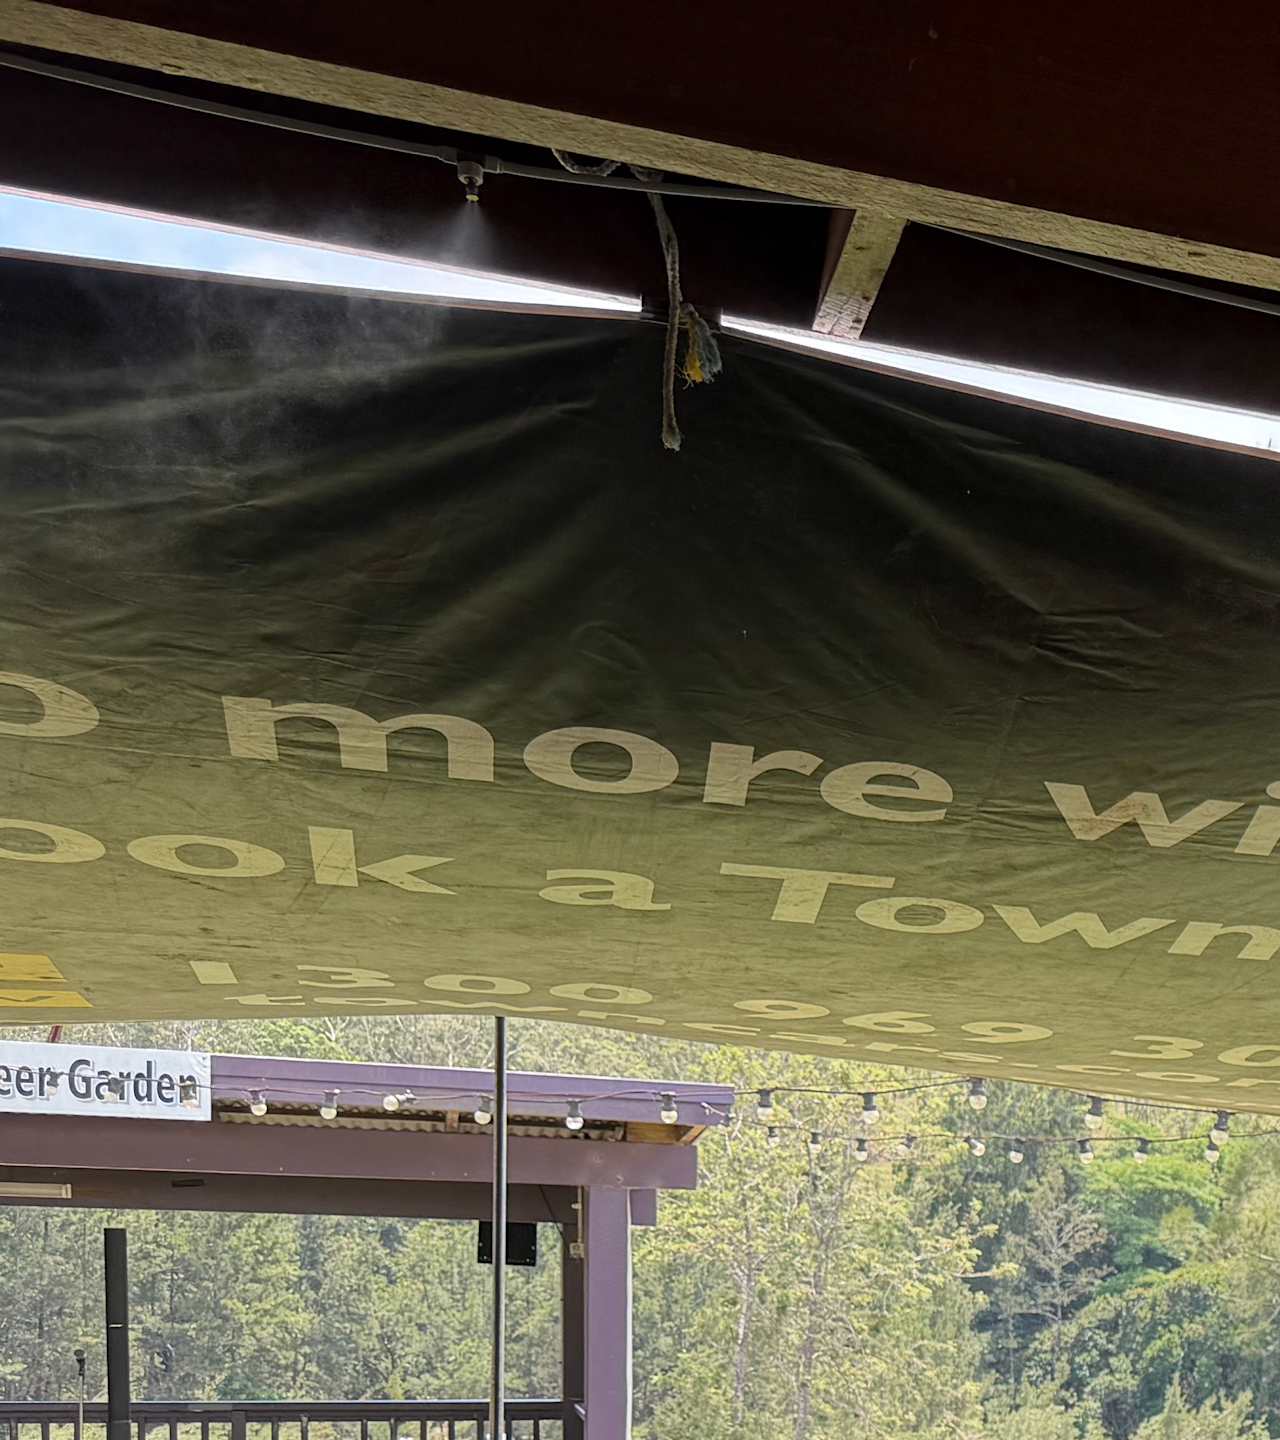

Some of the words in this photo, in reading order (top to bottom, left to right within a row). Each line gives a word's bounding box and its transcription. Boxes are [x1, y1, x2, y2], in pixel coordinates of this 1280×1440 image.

[222, 696, 953, 821] more
[538, 868, 671, 911] a
[189, 960, 653, 1005] 1300
[733, 999, 1053, 1044] 969
[69, 1059, 197, 1104] Garden
